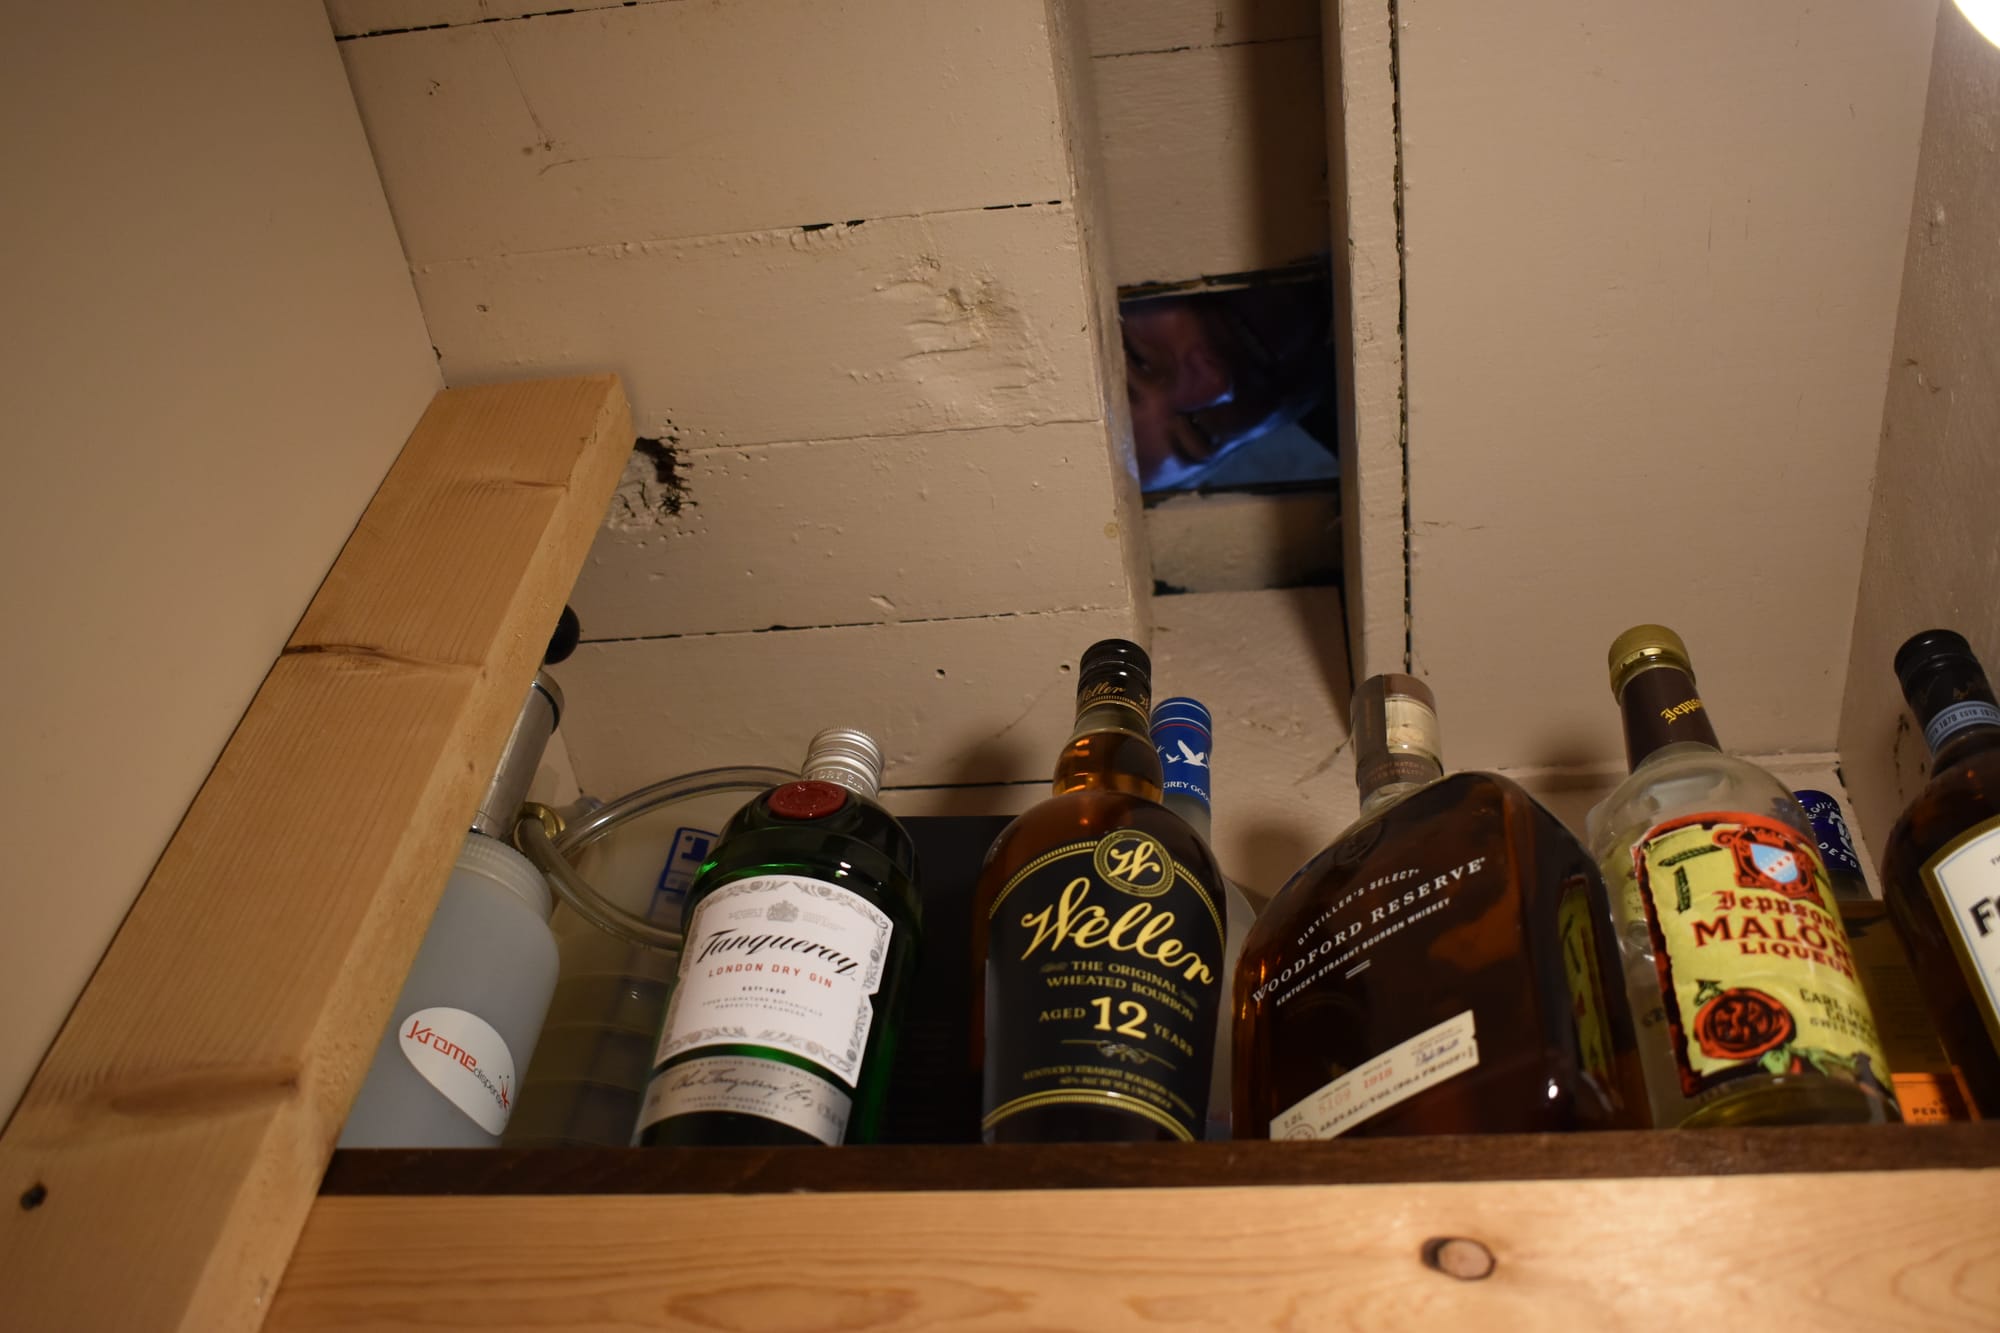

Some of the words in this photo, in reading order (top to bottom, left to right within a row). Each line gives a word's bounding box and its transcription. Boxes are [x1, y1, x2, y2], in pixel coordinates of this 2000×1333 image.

[1162, 781, 1189, 789] GREY
[1818, 842, 1858, 868] DESD
[1021, 877, 1214, 984] Weller
[1252, 921, 1363, 1004] WOODFORD
[1371, 859, 1483, 924] RESERVE
[1297, 887, 1364, 946] DISTILLER'S
[1369, 868, 1418, 891] SELECT
[1968, 895, 2000, 938] F
[696, 928, 860, 978] Tanqueray
[1276, 975, 1316, 1006] KENTUCKY
[1318, 947, 1359, 977] STRAIGHT
[1361, 921, 1405, 949] BOURBON
[1407, 897, 1450, 925] WHISKEY
[1691, 914, 1854, 968] MALÖR
[1739, 941, 1853, 981] LIQUEUR
[708, 963, 763, 977] LONDON
[771, 963, 801, 977] DRY
[810, 973, 832, 988] GIN
[1047, 975, 1127, 991] WHEATED
[1131, 981, 1194, 1022] BOURBON
[1072, 960, 1103, 972] THE
[1108, 963, 1179, 996] ORIGINAL
[406, 1020, 478, 1073] Krome
[1039, 1007, 1087, 1022] AGED
[1091, 996, 1148, 1040] 12
[1153, 1023, 1194, 1057] YEARS
